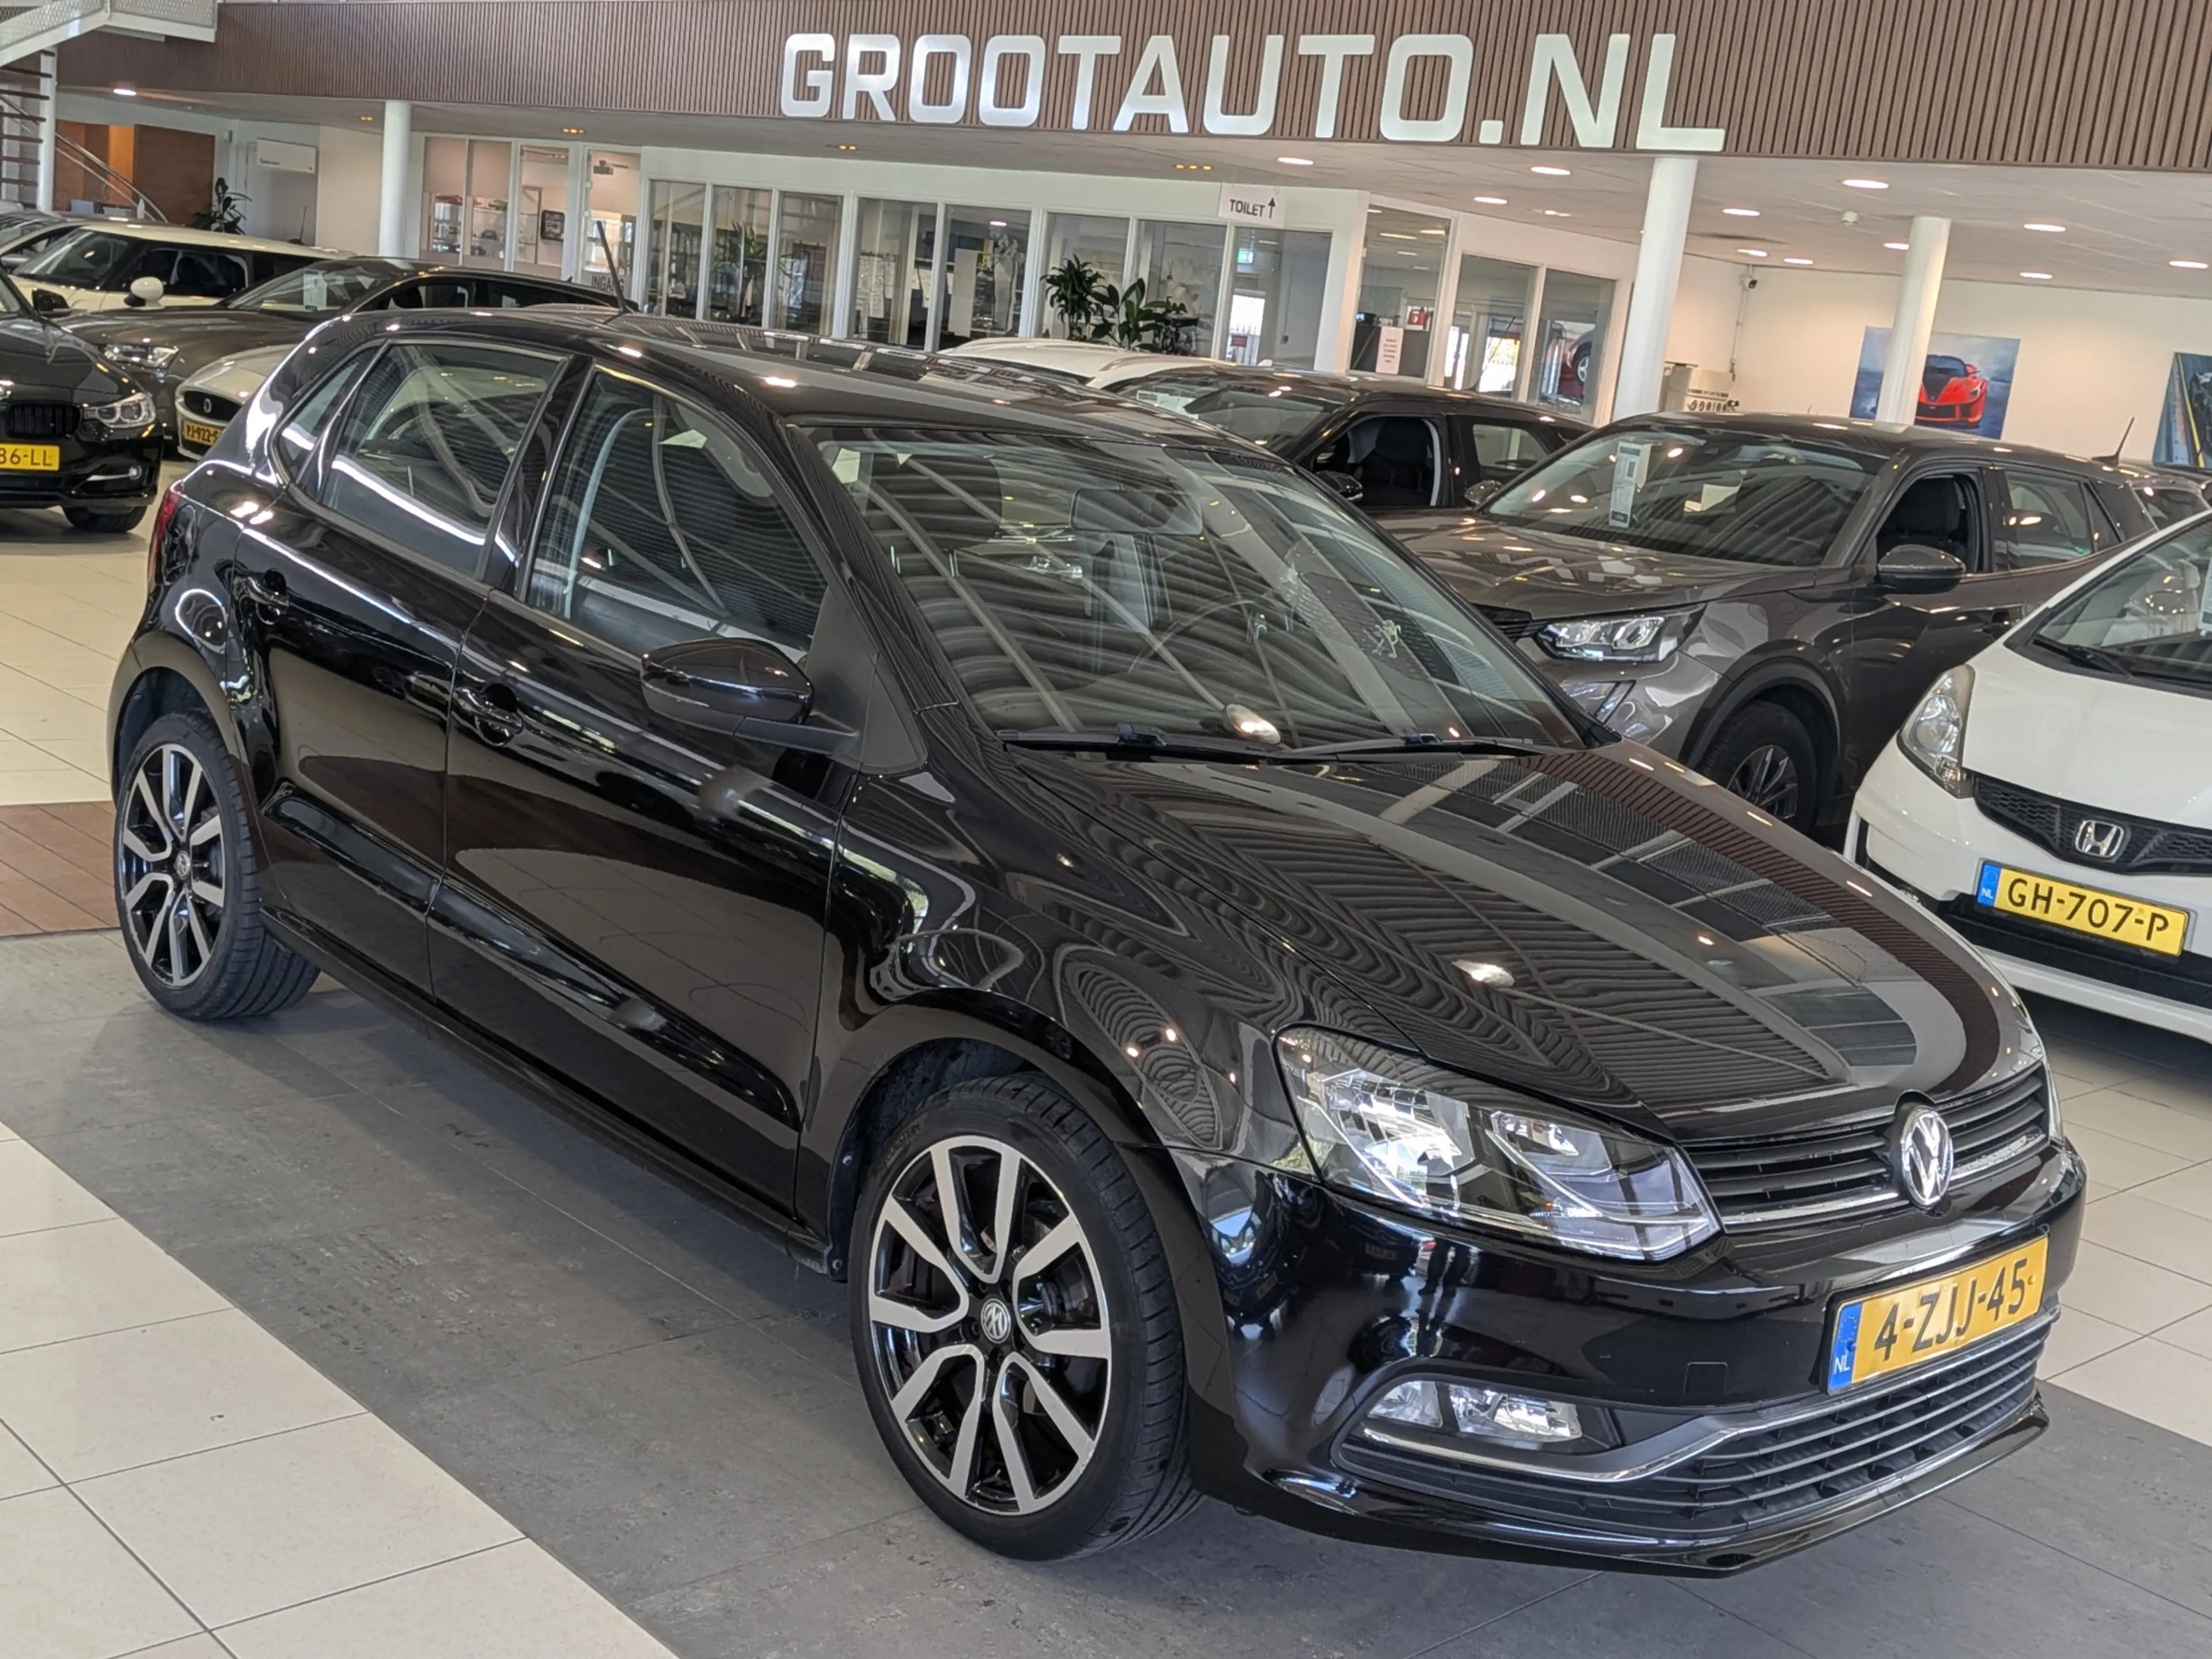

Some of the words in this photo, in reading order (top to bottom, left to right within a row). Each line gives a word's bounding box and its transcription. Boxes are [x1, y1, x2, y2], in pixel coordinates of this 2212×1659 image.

[781, 33, 1725, 151] GROOTAUTO.NL
[1229, 199, 1266, 217] TOILET
[591, 274, 624, 292] INGAG
[1982, 887, 1994, 899] NL
[2008, 877, 2169, 941] GH-707-P
[1874, 1257, 2028, 1361] 4-ZJJ-45
[1834, 1354, 1850, 1374] NL
